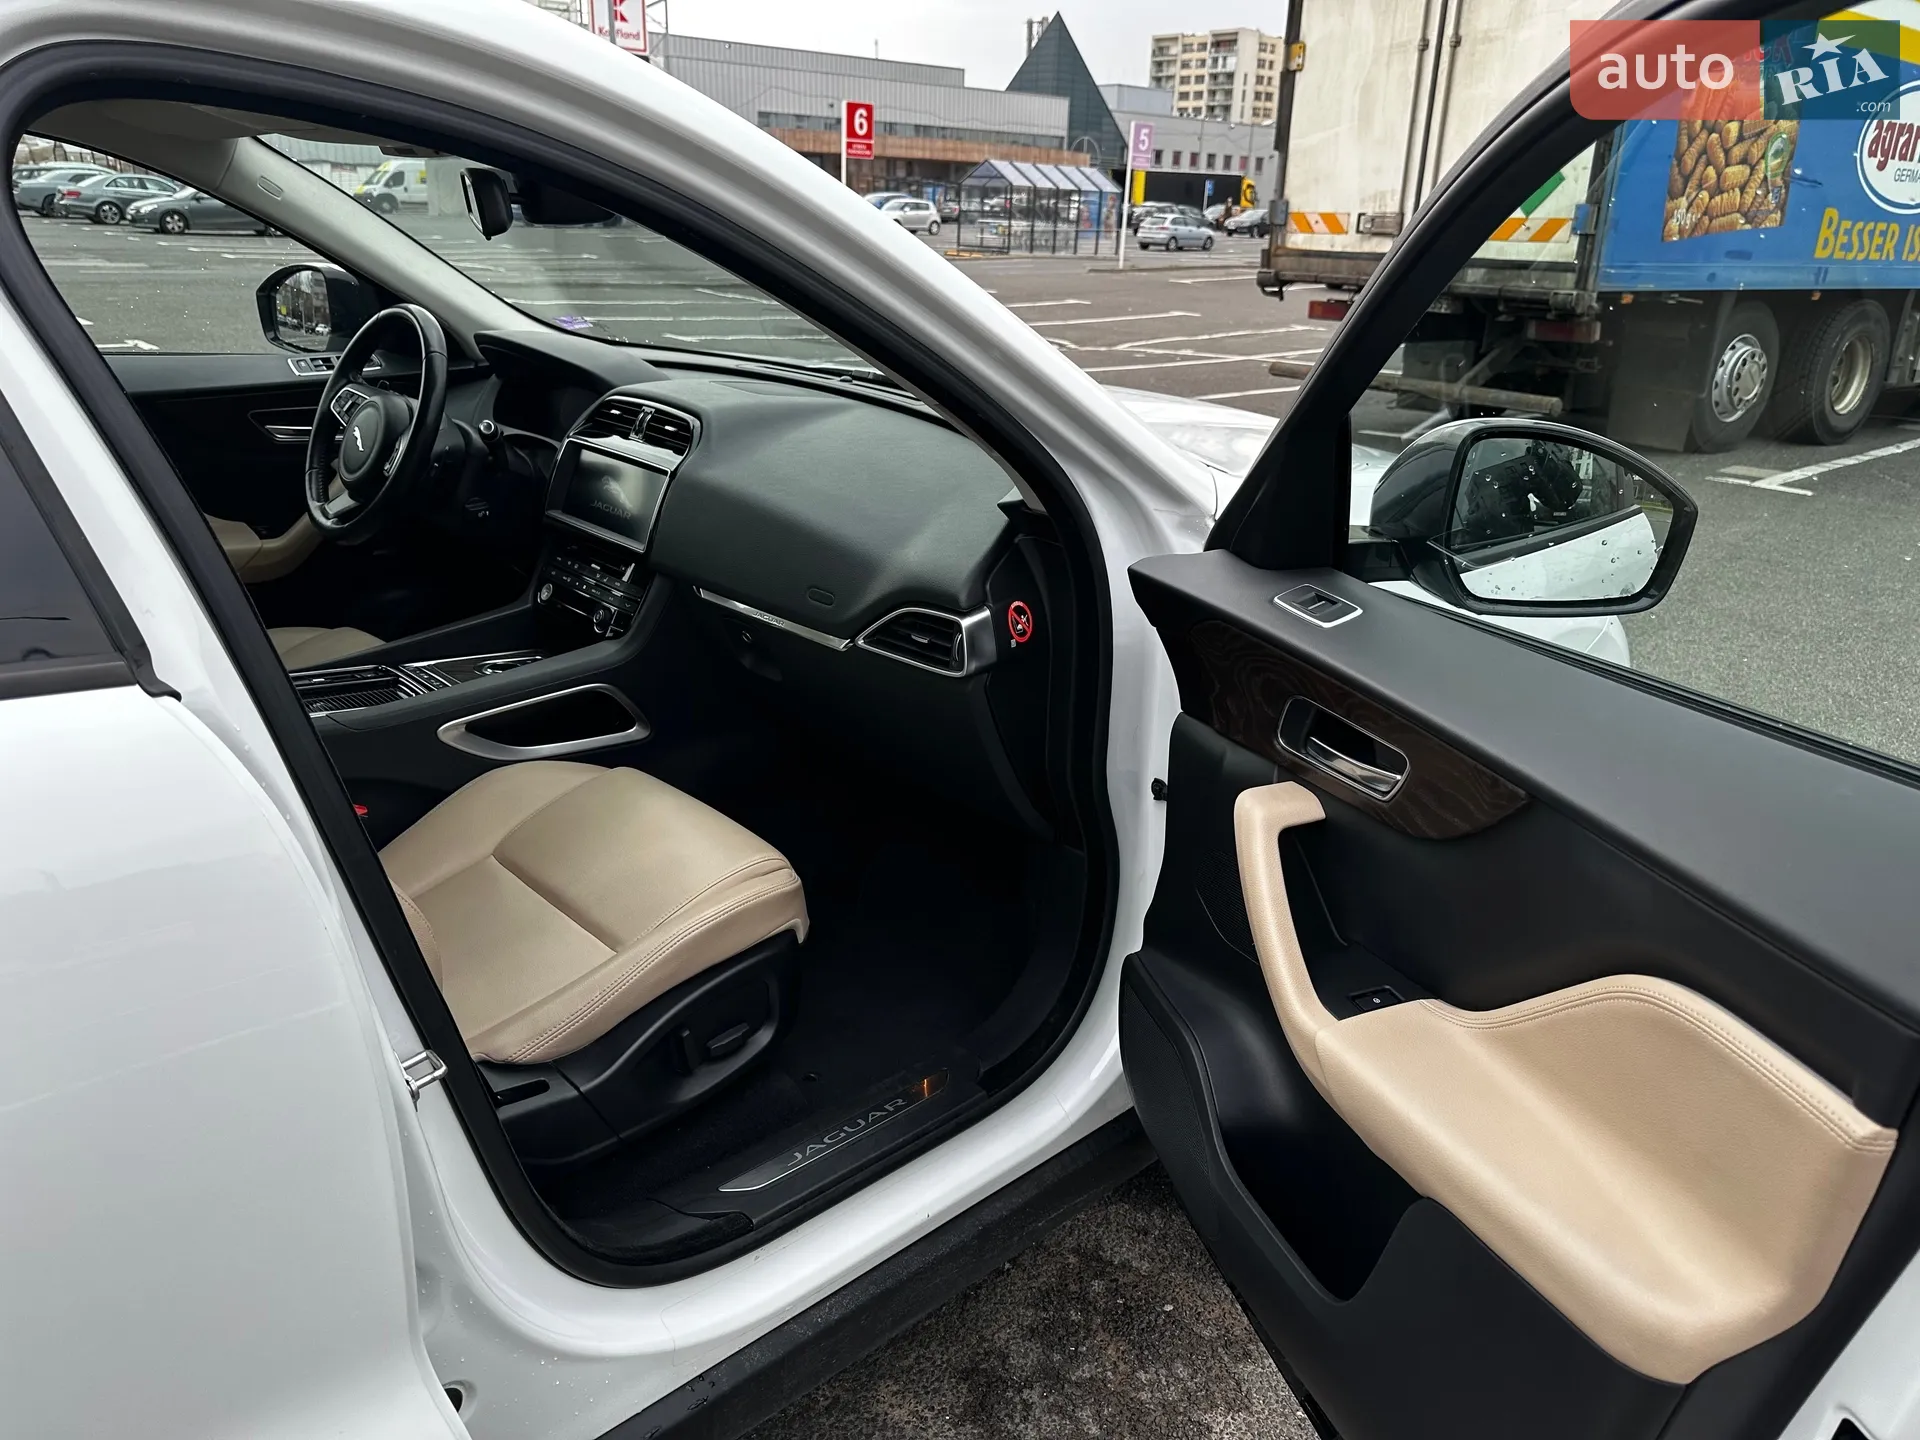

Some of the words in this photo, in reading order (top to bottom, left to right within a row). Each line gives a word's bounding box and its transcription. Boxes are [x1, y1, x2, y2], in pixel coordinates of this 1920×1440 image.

[598, 25, 641, 41] Kafland
[854, 107, 868, 136] 6
[1138, 128, 1150, 151] 5
[1867, 119, 1920, 172] agrar
[1902, 223, 1920, 261] IS
[590, 499, 632, 519] JAGUAR
[787, 1098, 907, 1167] JAGUAR
